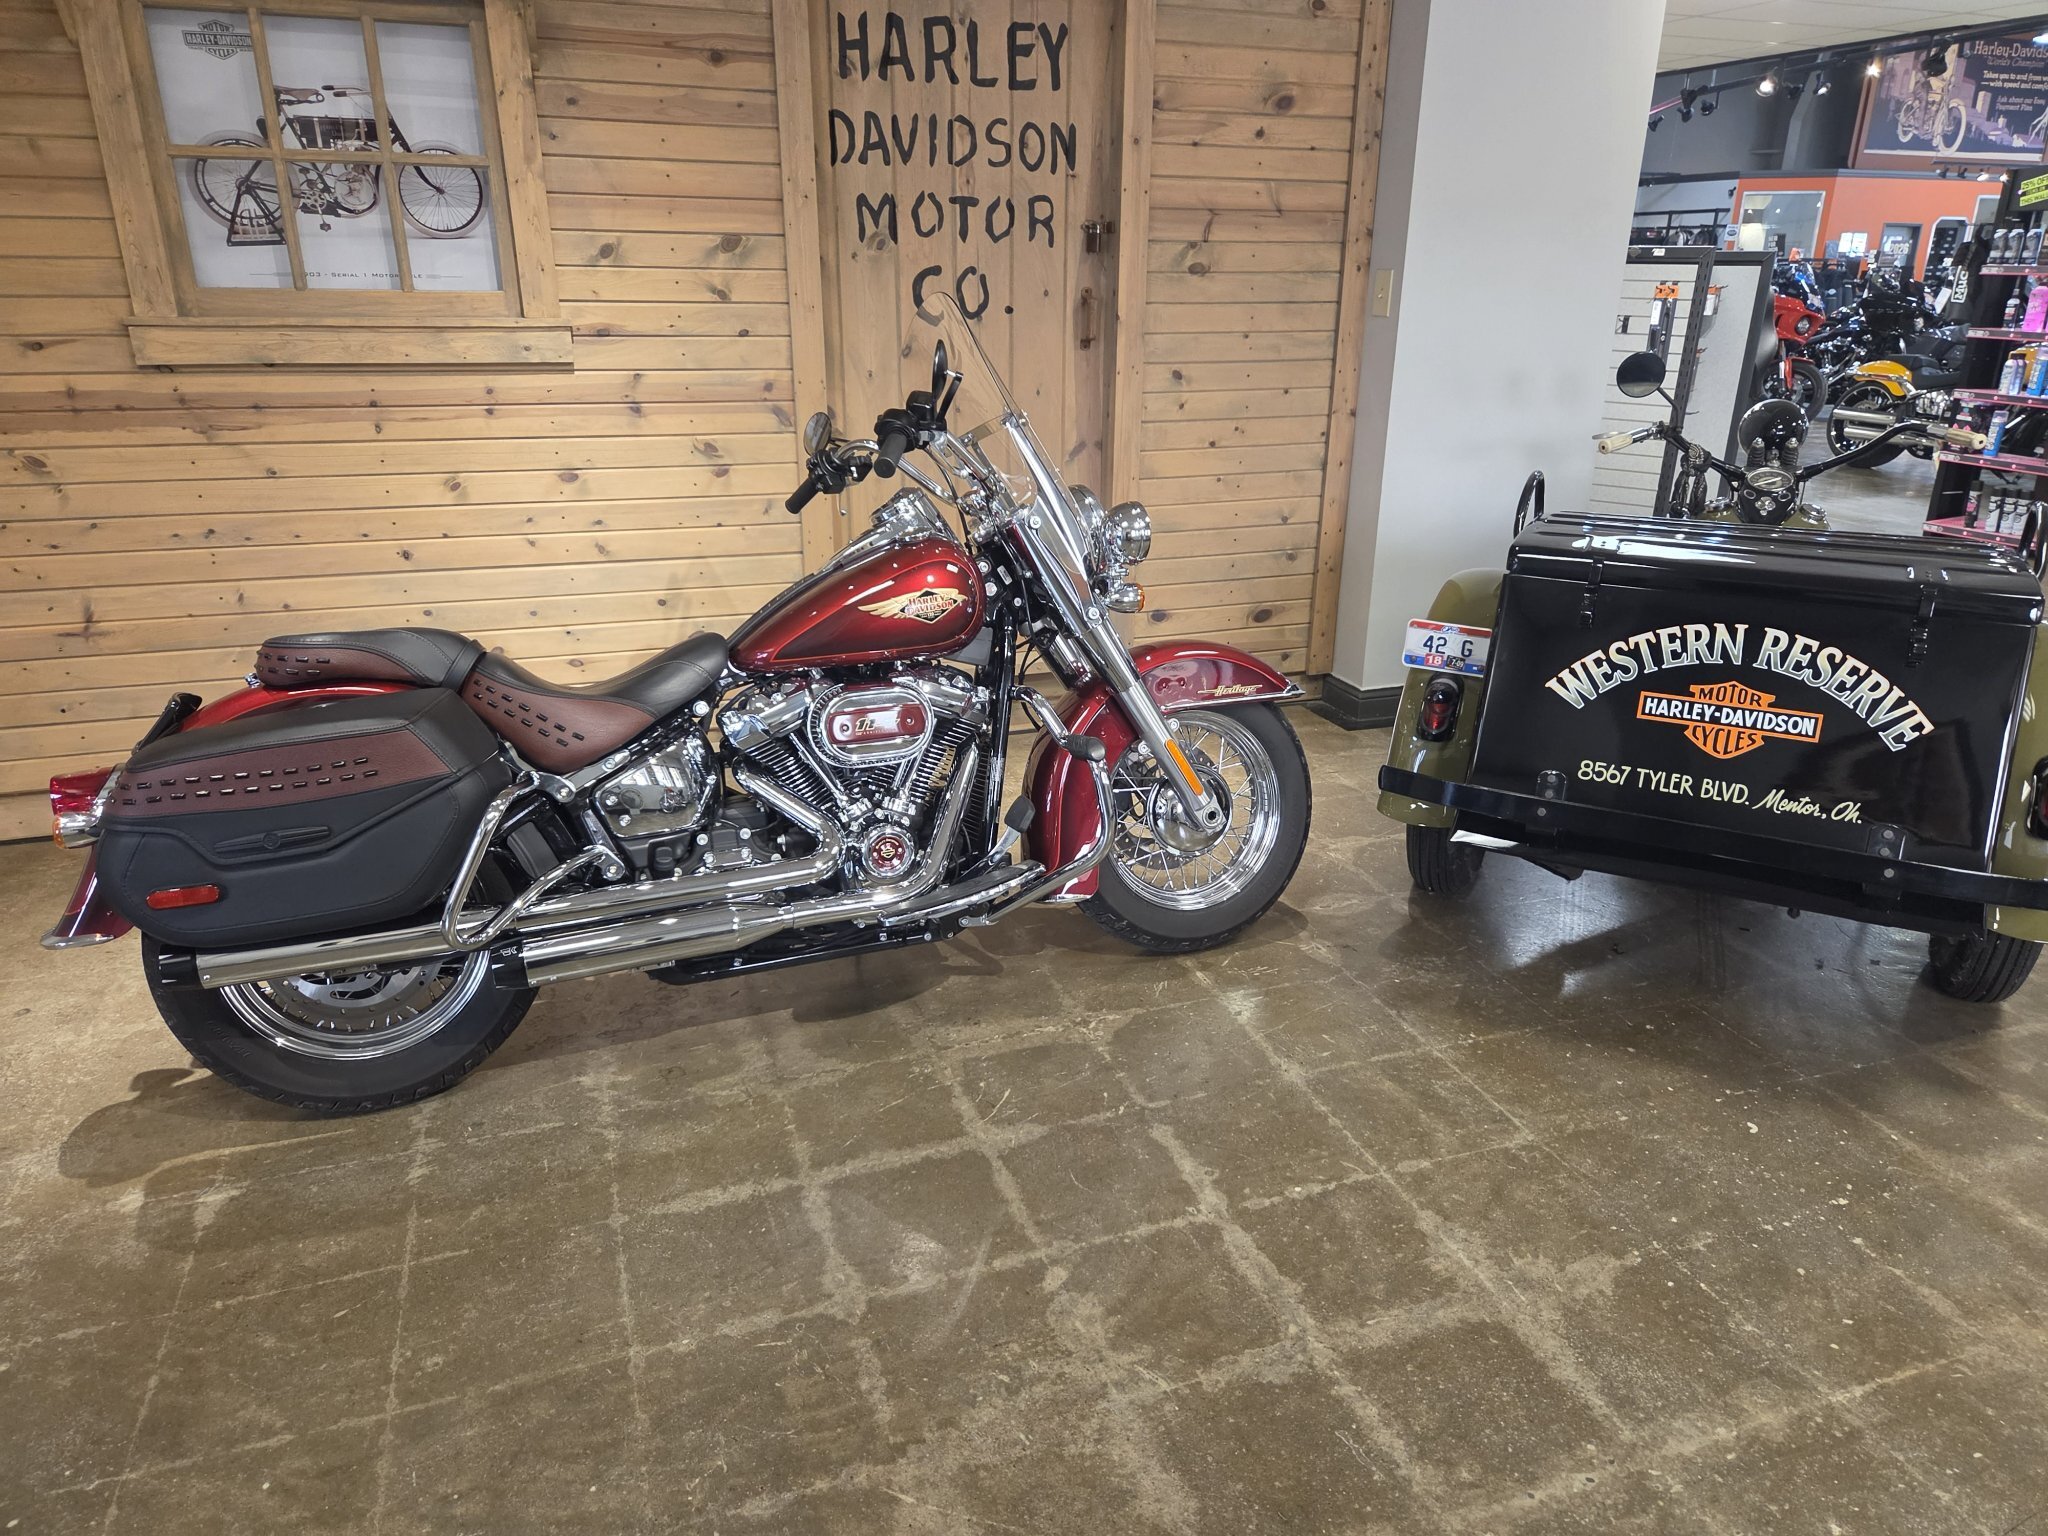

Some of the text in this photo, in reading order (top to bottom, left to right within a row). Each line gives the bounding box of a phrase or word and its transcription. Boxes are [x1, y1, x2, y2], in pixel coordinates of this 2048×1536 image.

[201, 21, 231, 32] MOTOR
[837, 11, 1068, 91] HARLEY
[828, 109, 1077, 175] DAVIDSON
[856, 190, 1054, 248] MOTOR
[912, 265, 1014, 326] CO.
[907, 601, 953, 616] DAVIDSON
[1423, 635, 1473, 657] 42 G
[1427, 655, 1442, 665] 18
[1545, 622, 1749, 710] WESTERN
[1206, 684, 1260, 697] Heritage
[1699, 684, 1762, 707] MOTOR
[1753, 627, 1936, 753] RESERVE
[1644, 698, 1816, 736] HARLEY-DAVIDSON
[1692, 725, 1757, 756] CYCLES
[1577, 760, 1863, 824] 8567 TYLER BLVD. Mentor, Oh.
